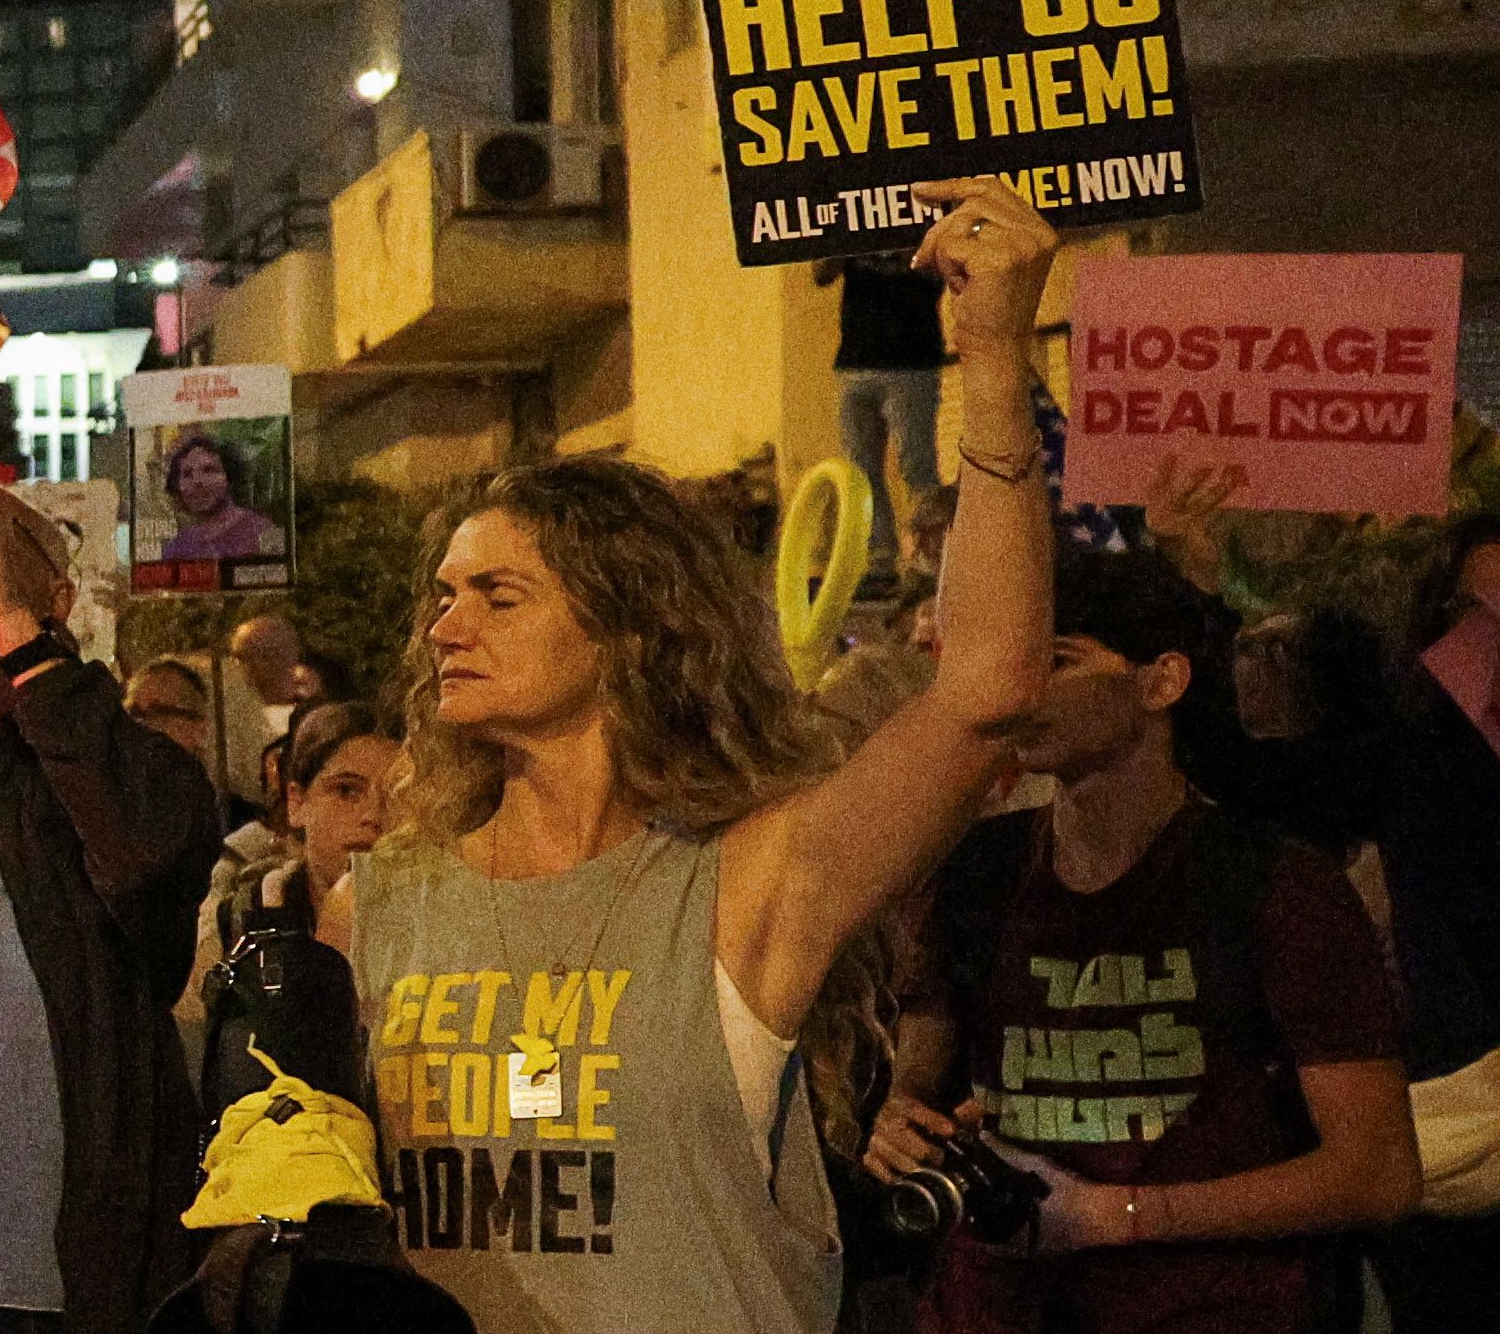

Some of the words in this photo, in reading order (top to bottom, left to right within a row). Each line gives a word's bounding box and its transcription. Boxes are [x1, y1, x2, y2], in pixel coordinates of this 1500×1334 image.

[732, 69, 930, 169] SAVE
[949, 35, 1176, 141] THEM!
[751, 196, 823, 244] ALL
[1077, 150, 1186, 205] NOW!
[1085, 324, 1438, 377] HOSTAGE
[1082, 389, 1260, 438] DEAL
[1278, 397, 1424, 440] NOW
[380, 970, 512, 1047] GET
[523, 970, 633, 1047] MY
